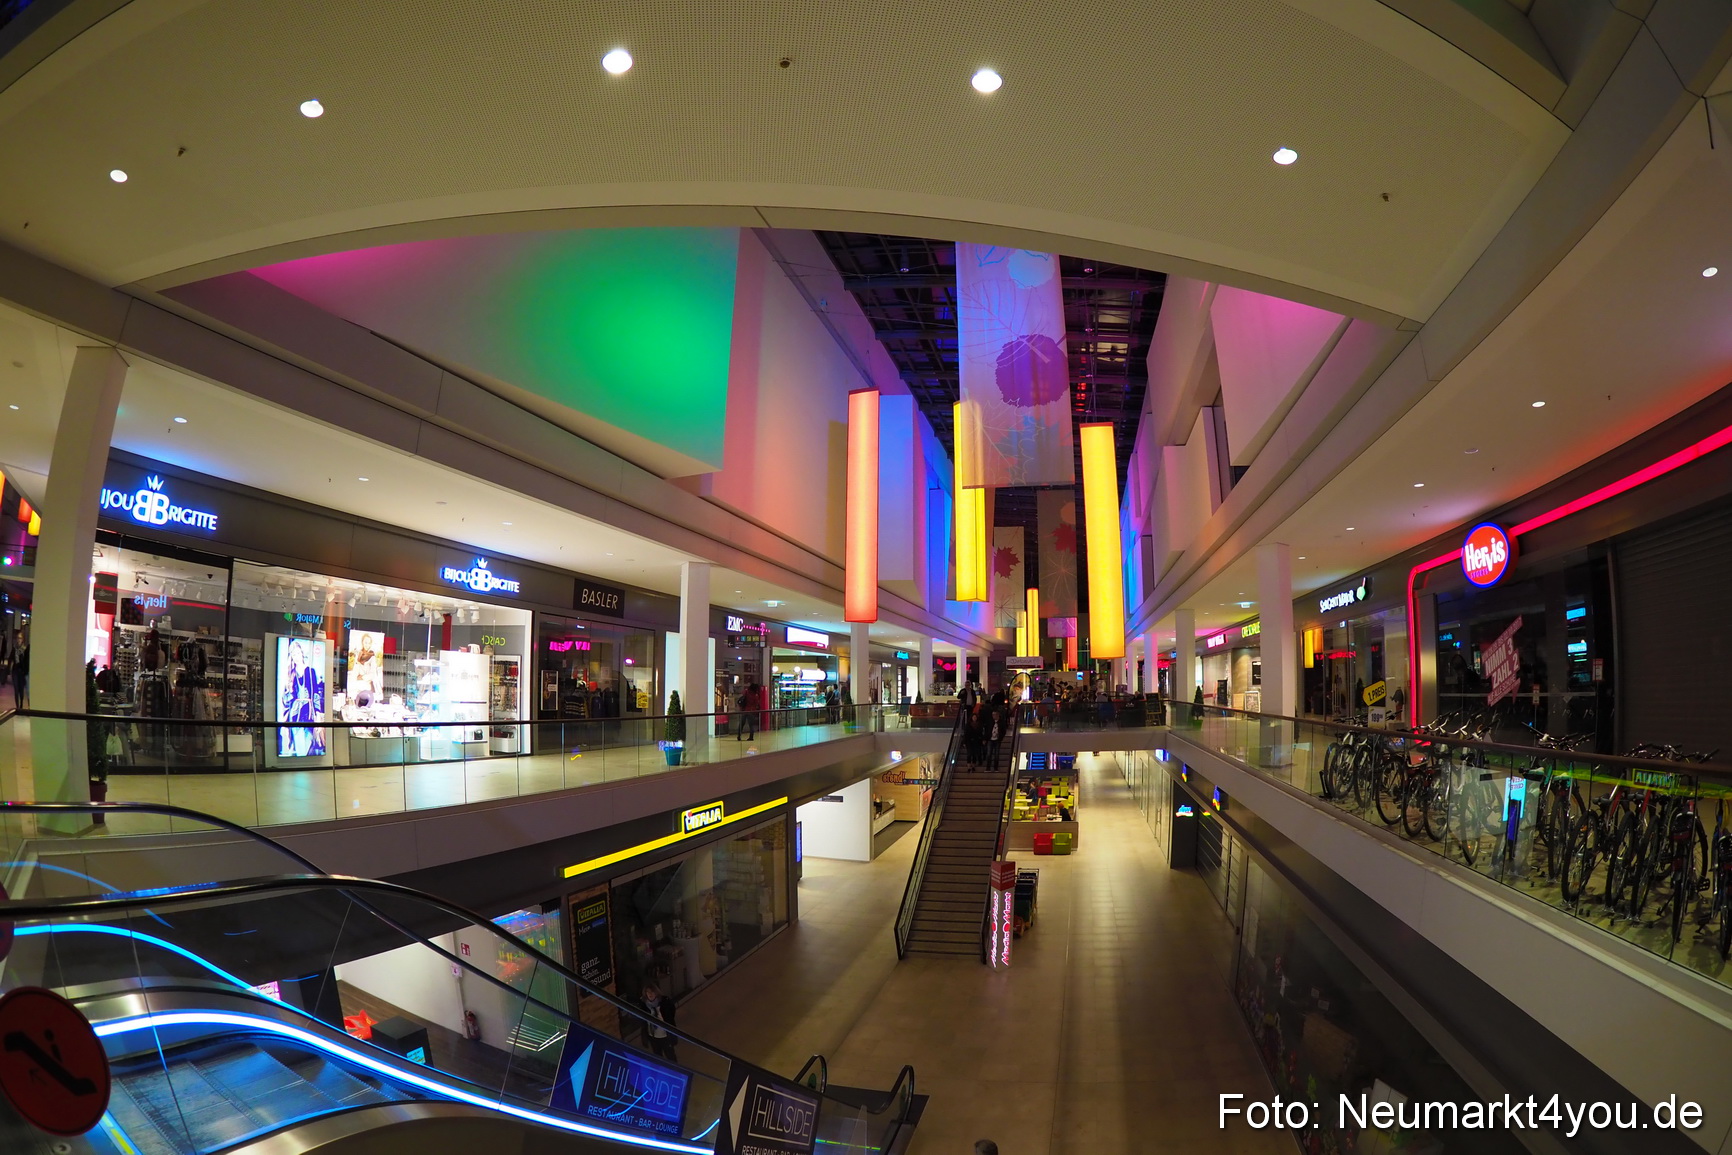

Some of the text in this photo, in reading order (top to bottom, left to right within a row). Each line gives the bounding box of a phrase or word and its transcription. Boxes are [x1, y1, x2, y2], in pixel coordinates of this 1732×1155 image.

[1464, 537, 1506, 572] Hervis
[581, 591, 619, 610] BASLER
[1485, 643, 1507, 677] NIMM
[1507, 637, 1514, 656] 3
[1492, 652, 1519, 689] ZAHL 2
[684, 807, 722, 831] VITALIA
[579, 904, 604, 920] VITALIA
[603, 1062, 681, 1110] HILLSIDE
[587, 1104, 679, 1134] RESTAURANT BAR LOUNGE
[754, 1096, 813, 1137] HILLSIDE
